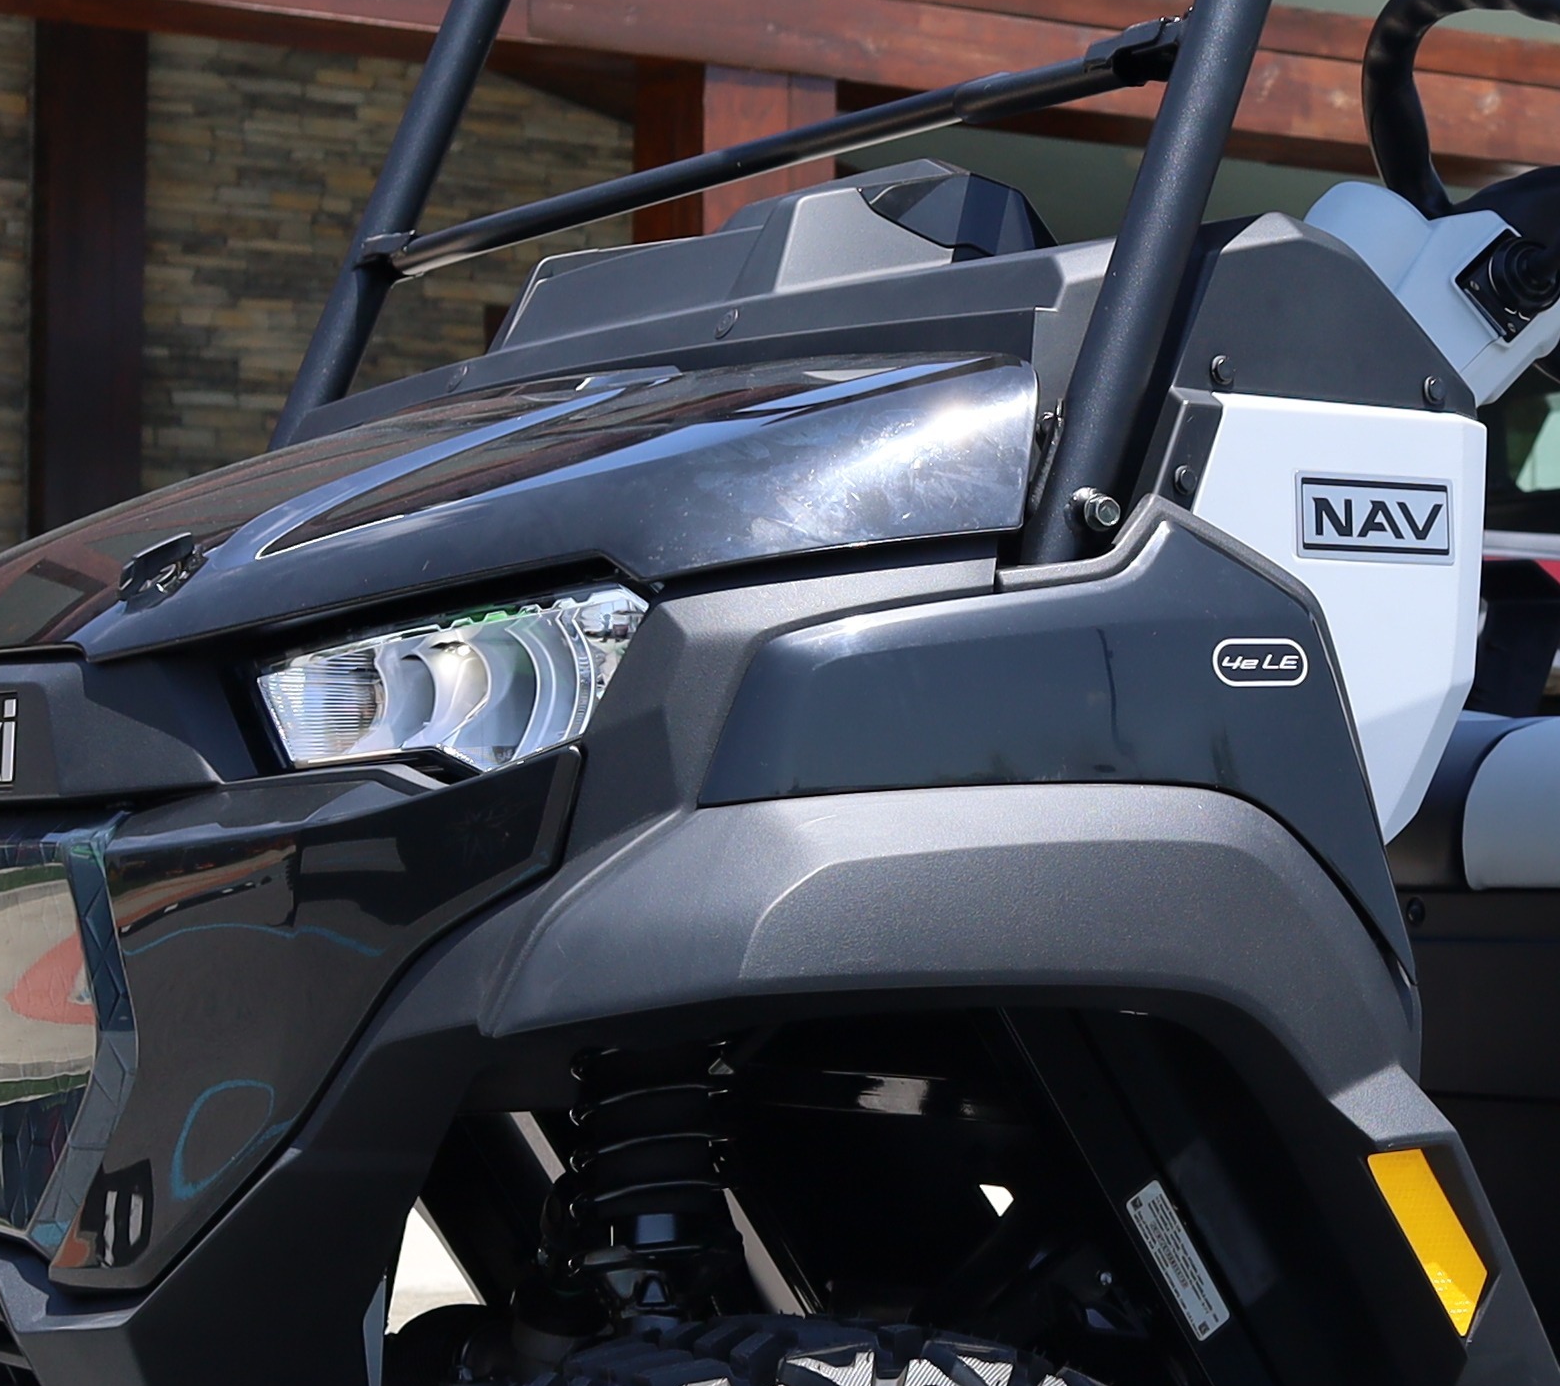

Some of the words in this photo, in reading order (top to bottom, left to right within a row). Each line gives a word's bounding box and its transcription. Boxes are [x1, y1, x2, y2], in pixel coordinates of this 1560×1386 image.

[1313, 497, 1443, 541] NAV
[1222, 655, 1259, 669] 4e
[1262, 654, 1298, 669] LE
